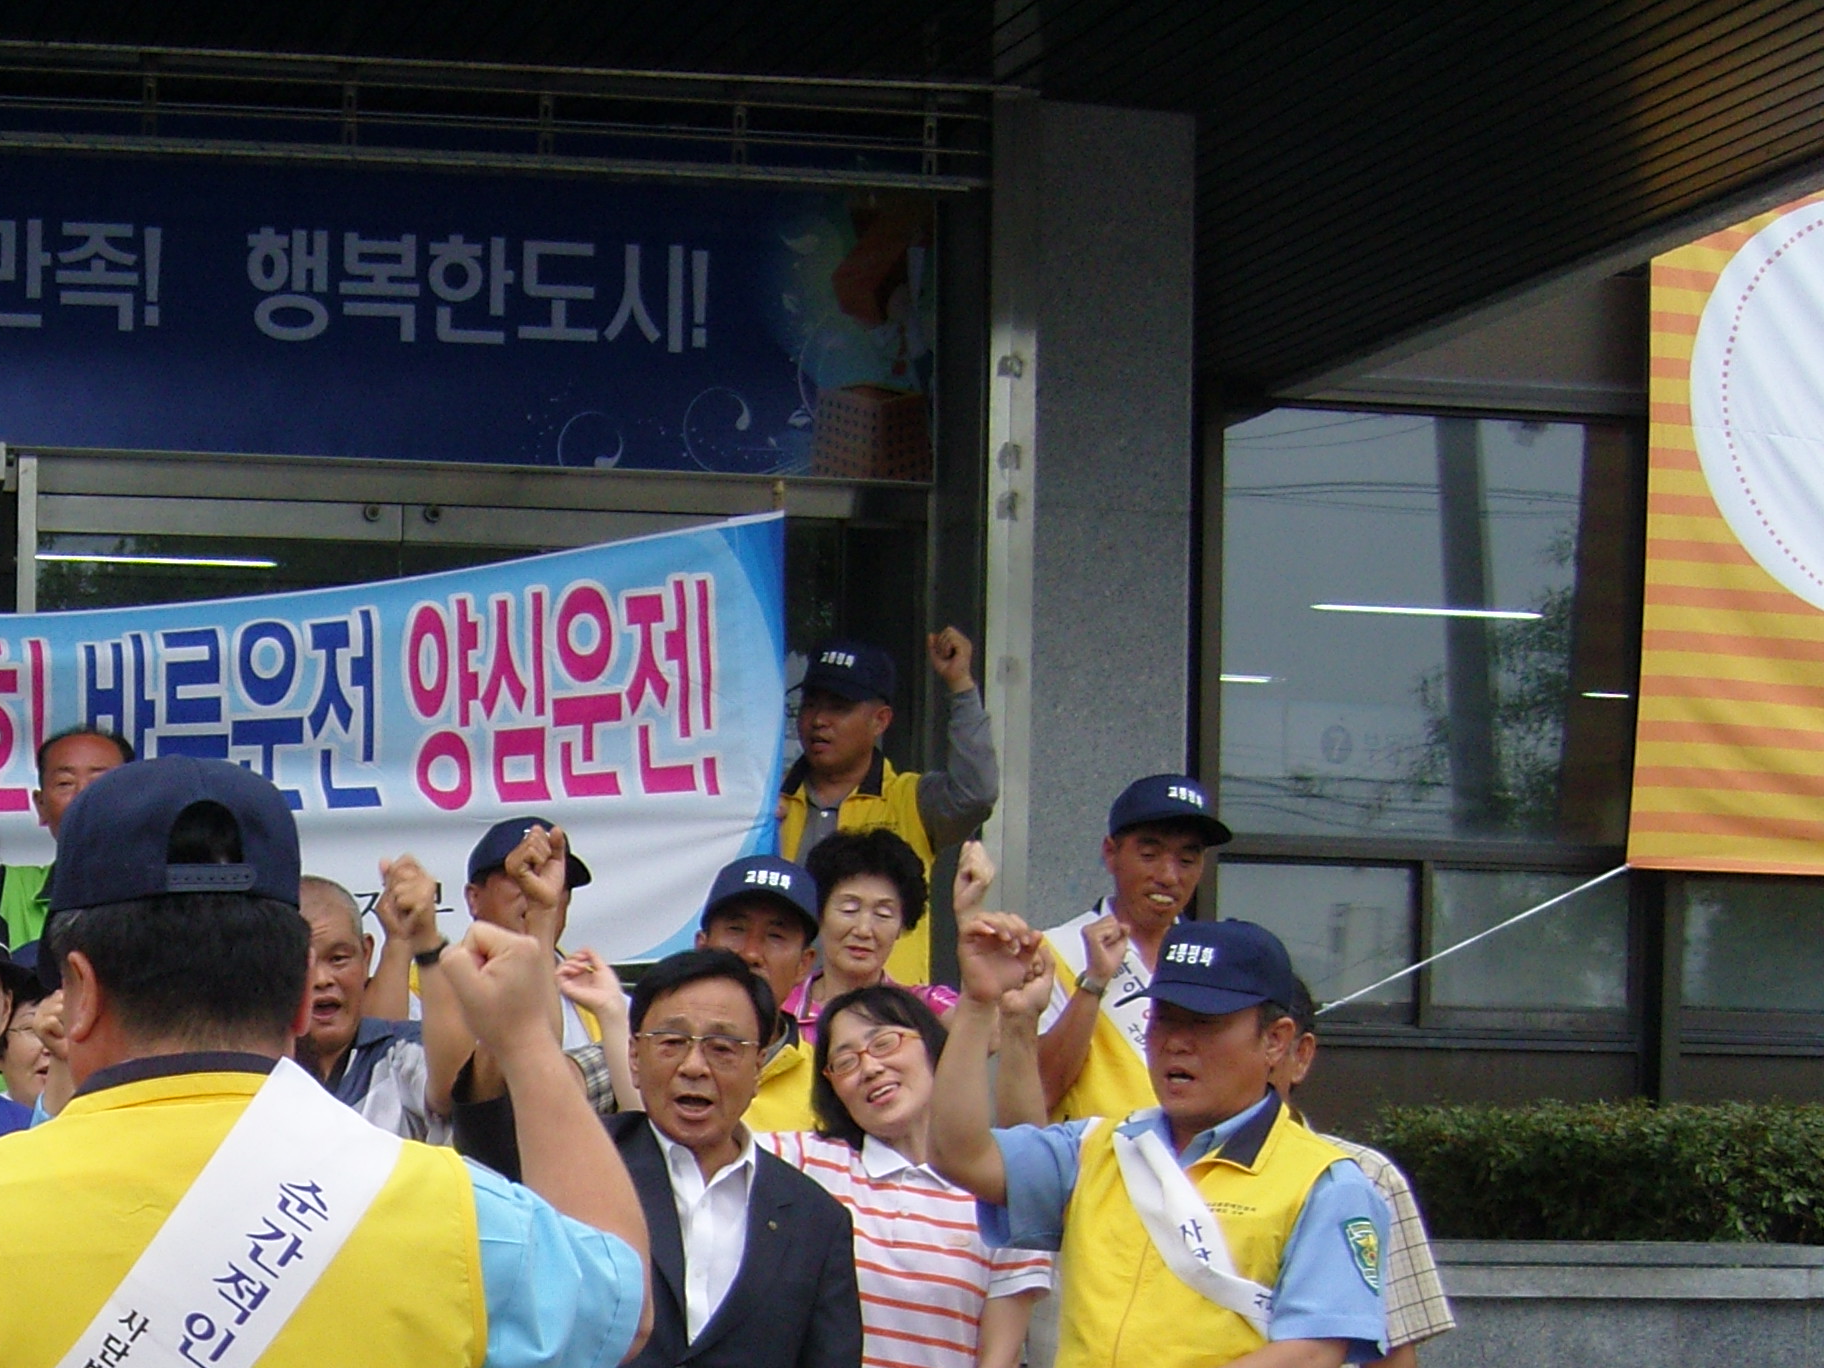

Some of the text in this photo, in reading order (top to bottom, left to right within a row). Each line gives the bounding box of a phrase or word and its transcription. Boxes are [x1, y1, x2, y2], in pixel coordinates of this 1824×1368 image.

[245, 227, 710, 352] 행복한도시!
[409, 579, 720, 810] 양심운전!
[745, 870, 791, 890] 교통평화
[1166, 943, 1215, 967] 교통평화
